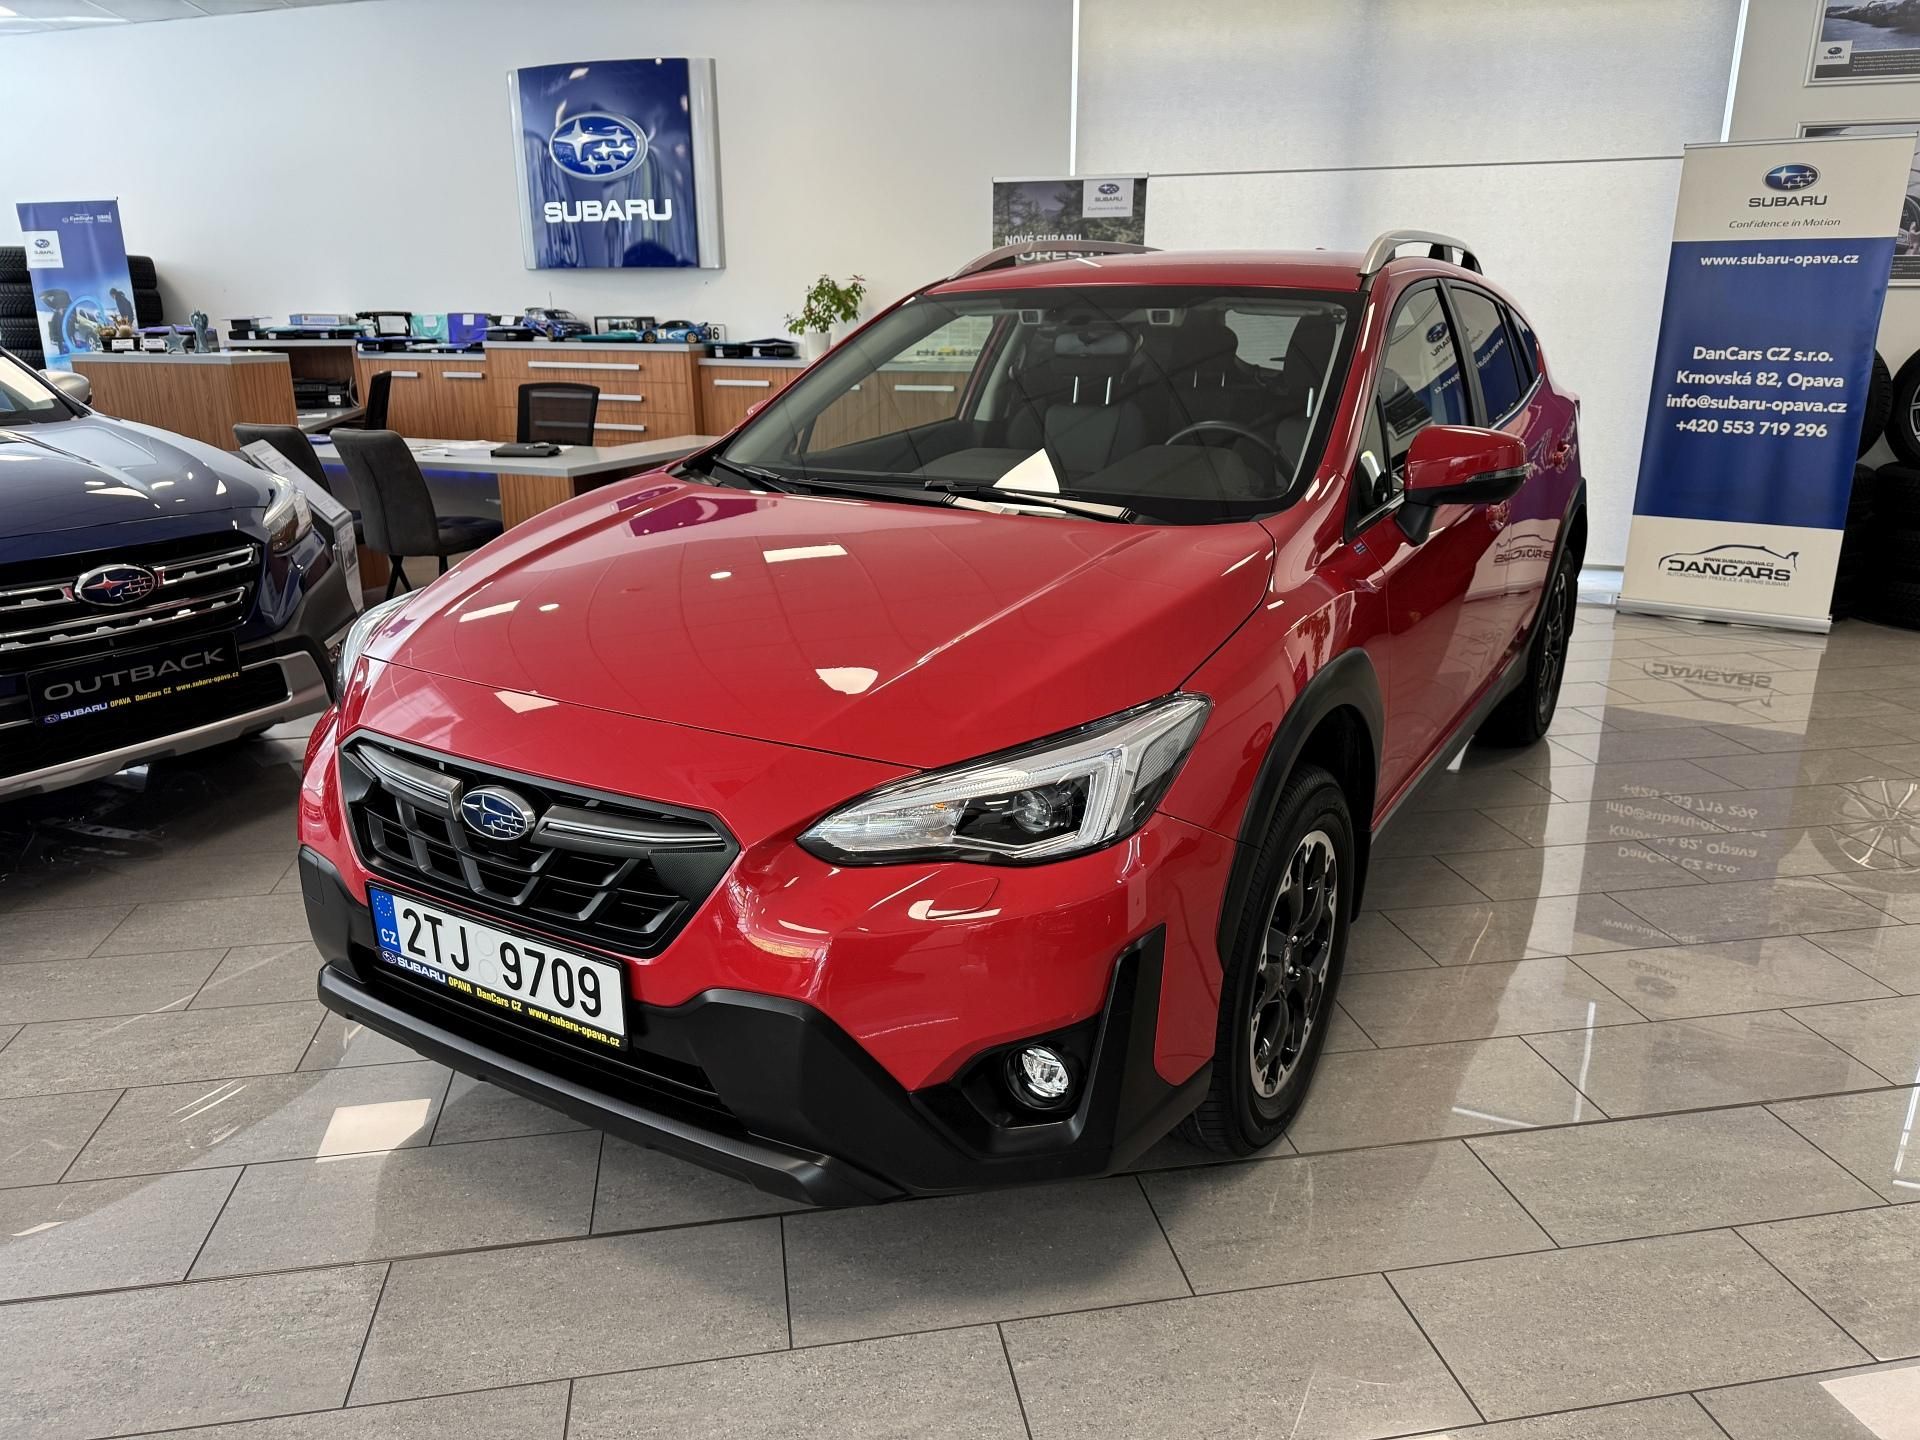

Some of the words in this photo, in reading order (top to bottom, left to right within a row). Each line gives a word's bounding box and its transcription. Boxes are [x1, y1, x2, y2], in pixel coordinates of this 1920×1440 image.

[543, 199, 673, 223] SUBARU
[1748, 195, 1828, 208] SUBARU
[1728, 218, 1789, 230] Confidence
[1790, 218, 1801, 228] in
[1802, 217, 1842, 227] Motion
[1004, 232, 1035, 246] NOVÉ
[1700, 252, 1860, 268] www.subaru-opava.cz
[1692, 346, 1763, 361] DanCars
[1766, 347, 1792, 361] CZ
[1793, 350, 1834, 362] s.r.o.
[1676, 370, 1752, 386] Krnovská
[1755, 372, 1782, 388] 82,
[1787, 373, 1844, 390] Opava
[1666, 394, 1848, 414] info@subaru-opava.cz
[1676, 419, 1719, 434] +420
[1722, 420, 1755, 435] 553
[1759, 422, 1790, 436] 719
[1793, 423, 1829, 438] 296
[1667, 559, 1791, 581] DANCARS
[44, 648, 225, 701] OUTBACK
[60, 702, 108, 720] SUBARU
[110, 696, 132, 708] OPAVA
[135, 689, 162, 702] DanCars
[163, 686, 172, 695] CZ
[175, 671, 240, 692] www.subaru-opava.cz
[381, 928, 398, 945] CZ
[402, 907, 470, 972] 2TJ
[499, 941, 602, 1018] 9709
[397, 956, 446, 984] SUBARU
[447, 975, 473, 995] OPAVA
[476, 986, 509, 1008] DanCars
[511, 999, 523, 1012] CZ
[527, 1007, 621, 1048] www.subaru-opava.cz
